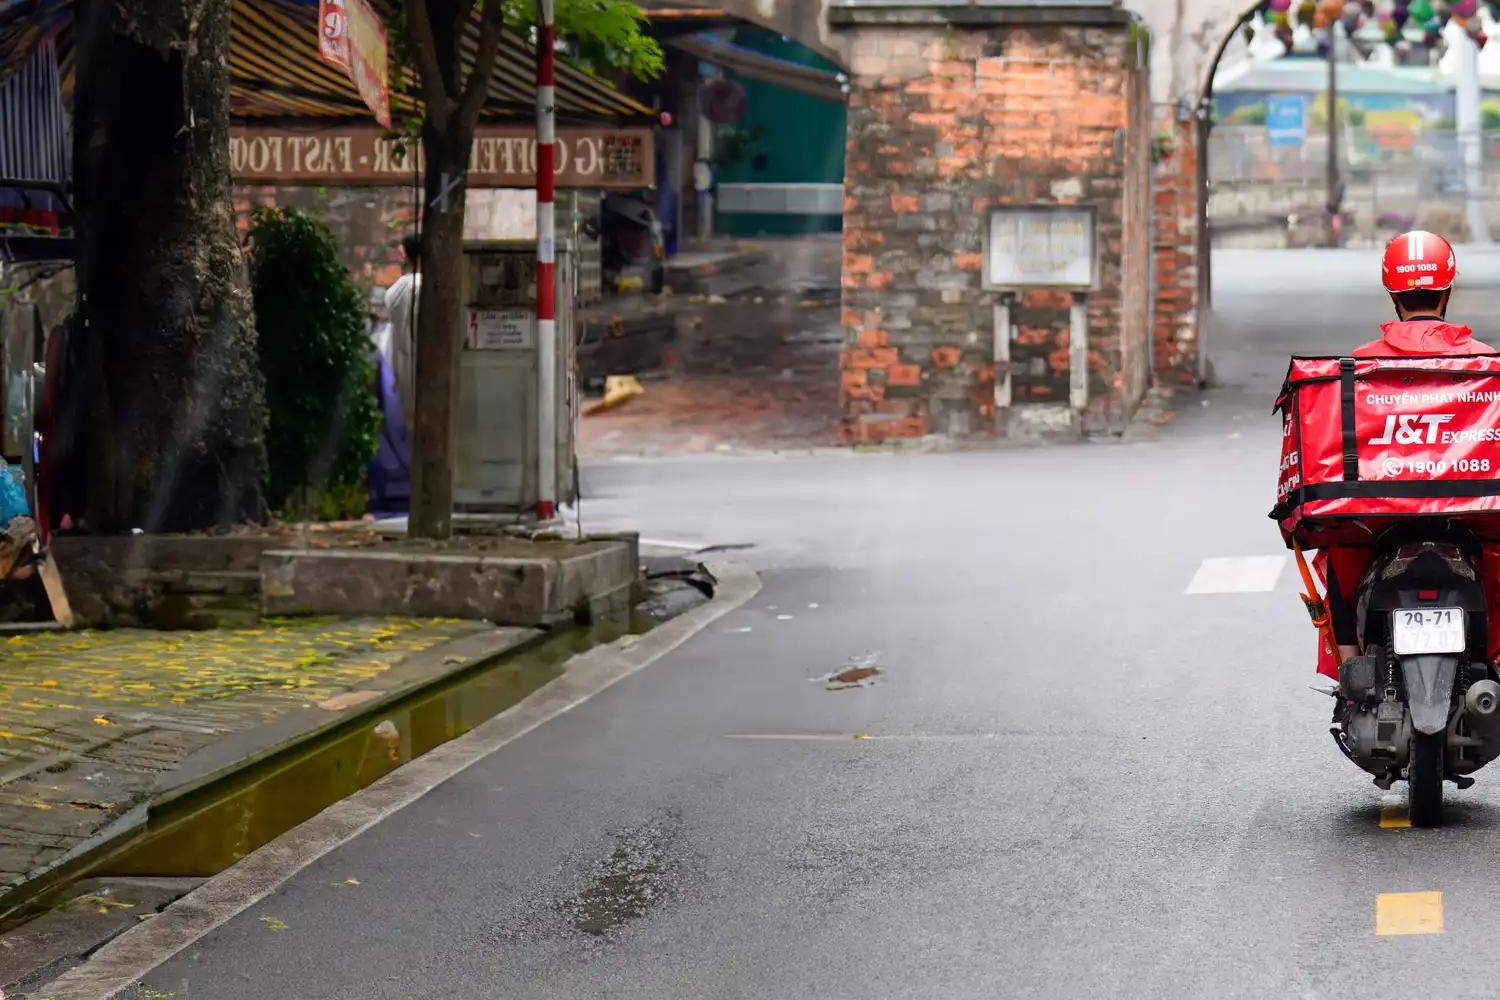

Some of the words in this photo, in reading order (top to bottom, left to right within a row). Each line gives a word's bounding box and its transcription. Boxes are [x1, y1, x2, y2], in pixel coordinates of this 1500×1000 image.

[1396, 264, 1416, 274] 1900
[1416, 263, 1438, 272] 1088
[1367, 413, 1456, 446] J&T
[1407, 461, 1447, 474] 1900
[1450, 458, 1491, 473] 1088
